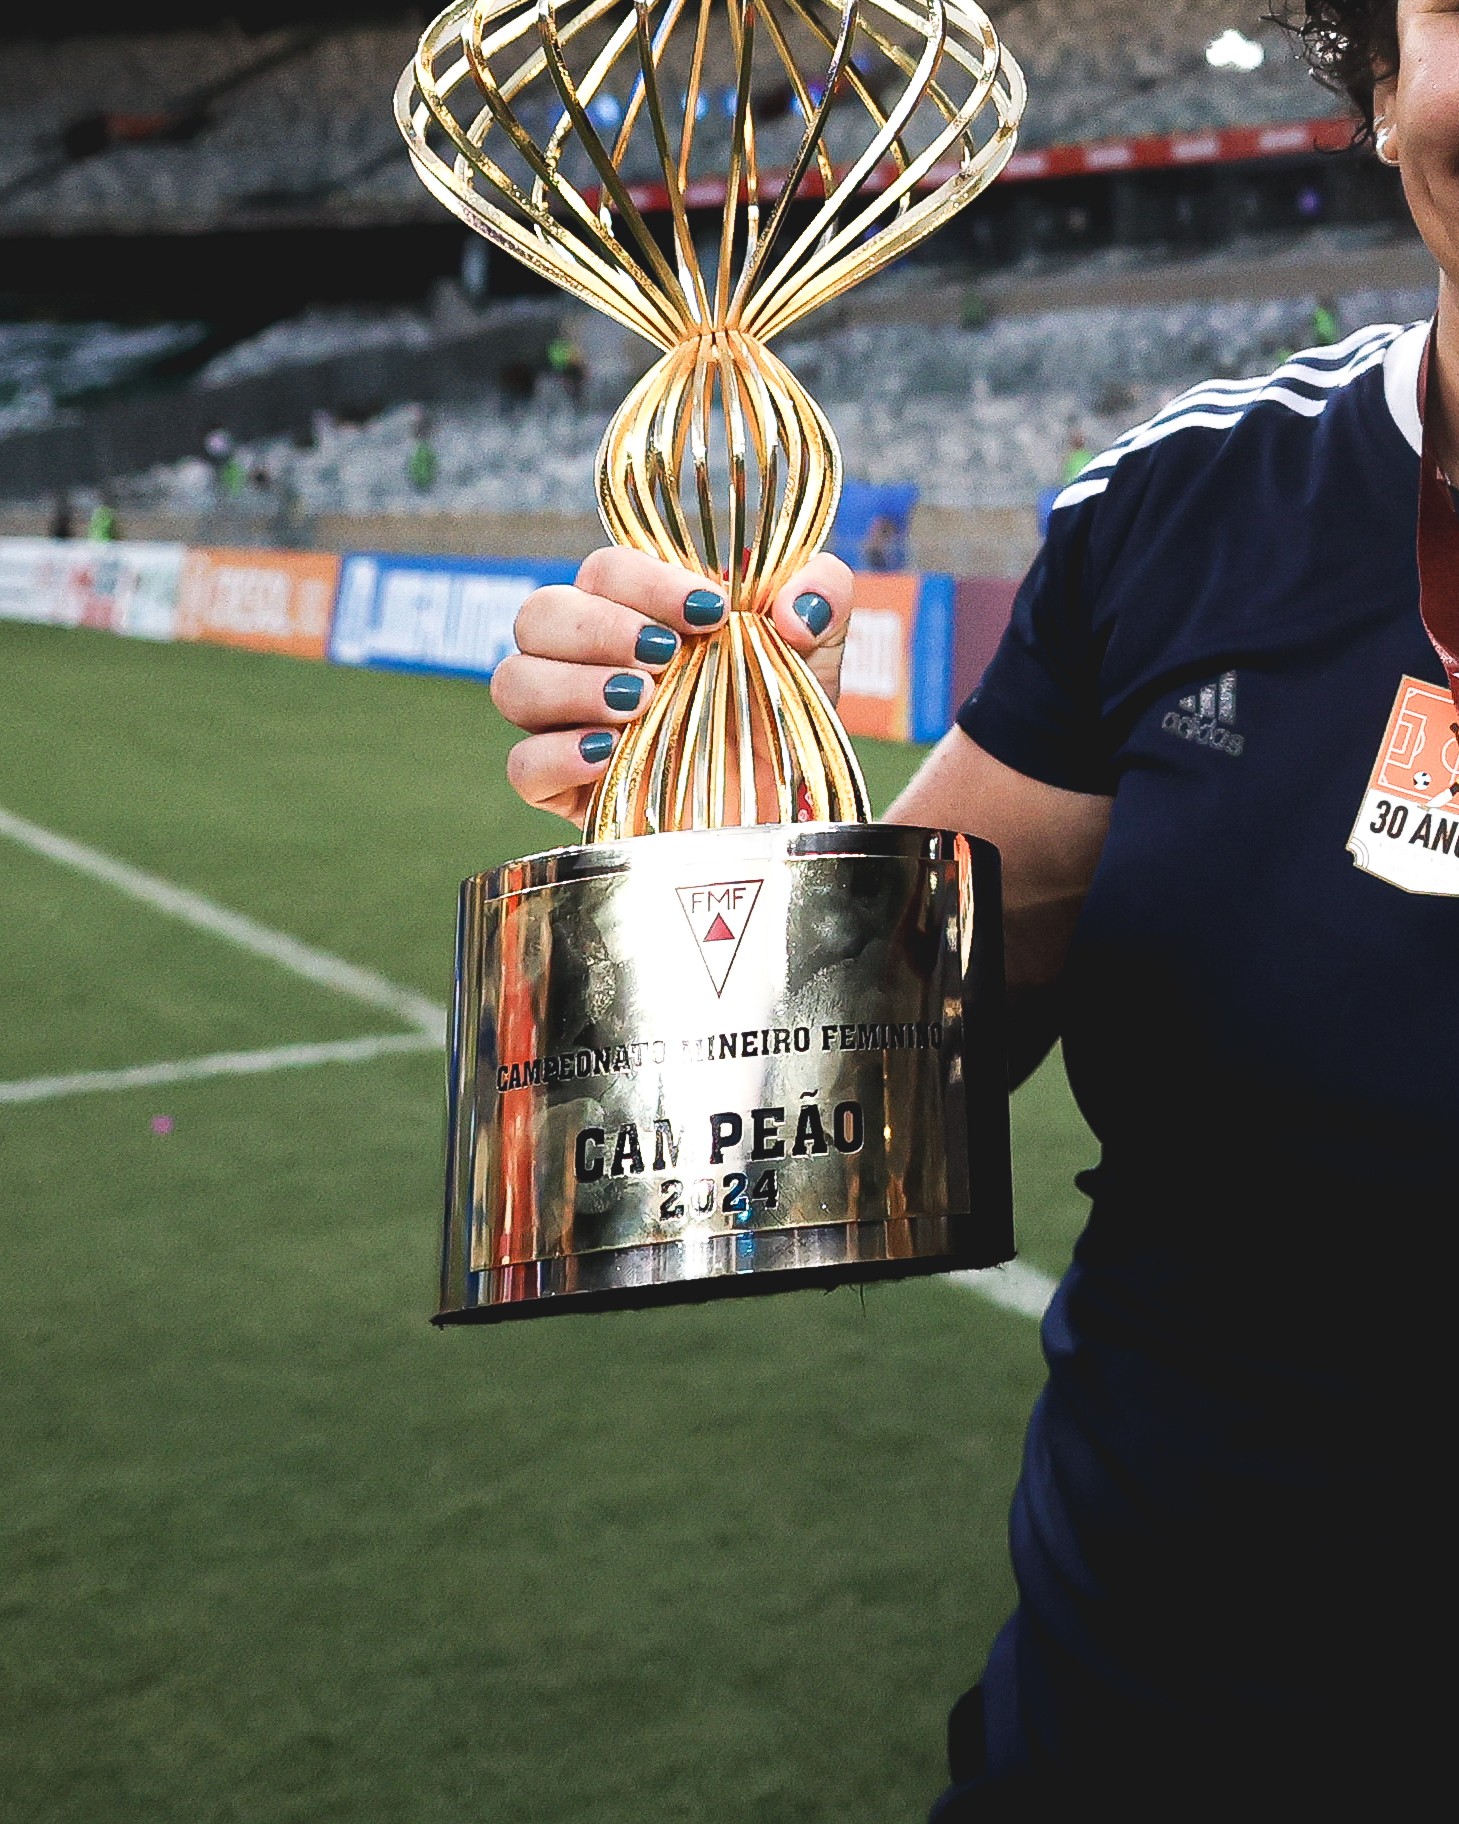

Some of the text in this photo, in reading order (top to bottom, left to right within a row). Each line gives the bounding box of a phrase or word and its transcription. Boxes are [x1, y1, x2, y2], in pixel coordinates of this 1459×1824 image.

[1161, 711, 1245, 757] adidas
[1369, 799, 1409, 840] 30
[691, 887, 747, 914] FMF
[495, 1040, 666, 1094] CAMPEONATO
[821, 1022, 945, 1053] FEMININO
[574, 1090, 866, 1184] CAMPEÃO
[658, 1168, 781, 1223] 2024
